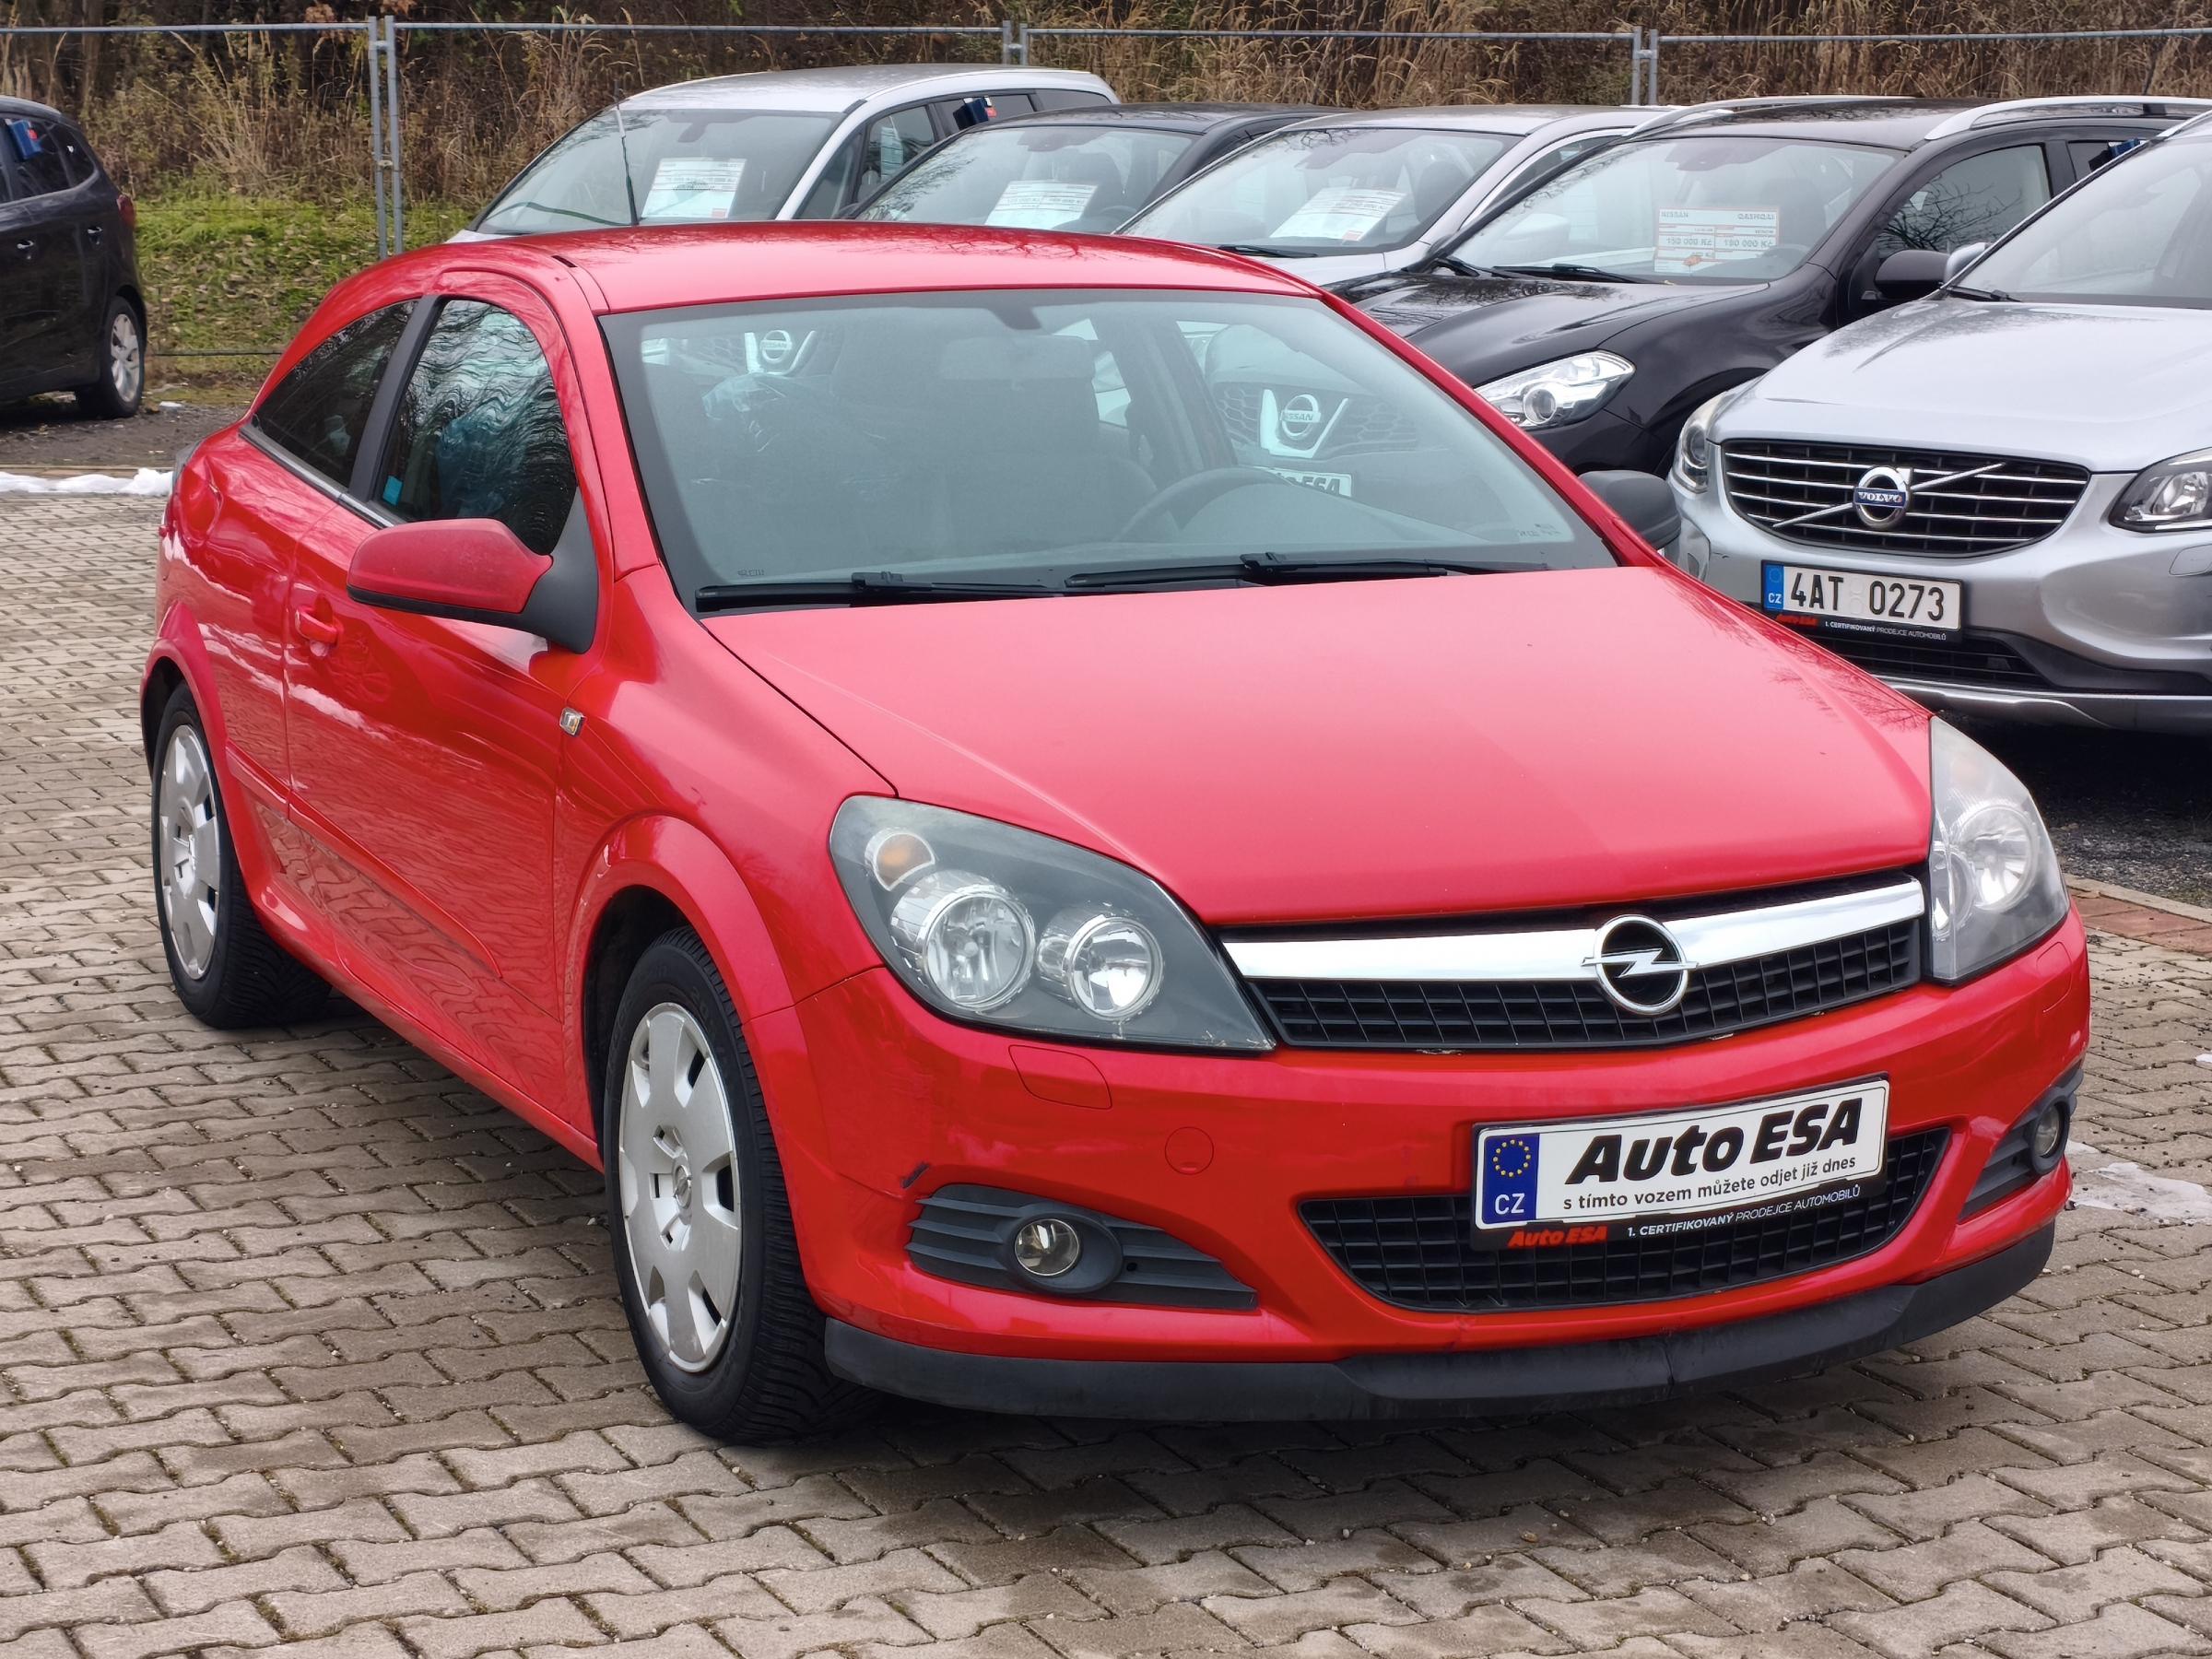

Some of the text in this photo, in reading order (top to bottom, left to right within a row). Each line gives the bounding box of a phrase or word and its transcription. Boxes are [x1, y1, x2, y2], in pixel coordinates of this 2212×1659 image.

[1857, 491, 1902, 503] VOLVO
[1768, 593, 1783, 605] CZ
[1790, 572, 1945, 621] 4AT 0273
[1877, 627, 1907, 637] PRODEJCE
[1565, 1098, 1863, 1185] Auto ESA
[1563, 1156, 1856, 1210] s tímto vozem můžete odjet již dnes
[1494, 1192, 1525, 1216] CZ
[1628, 1183, 1861, 1237] 1. CERTIFIKOVANÝ PRODEJCE AUTOMOBILŮ
[1507, 1224, 1608, 1249] Auto ESA
